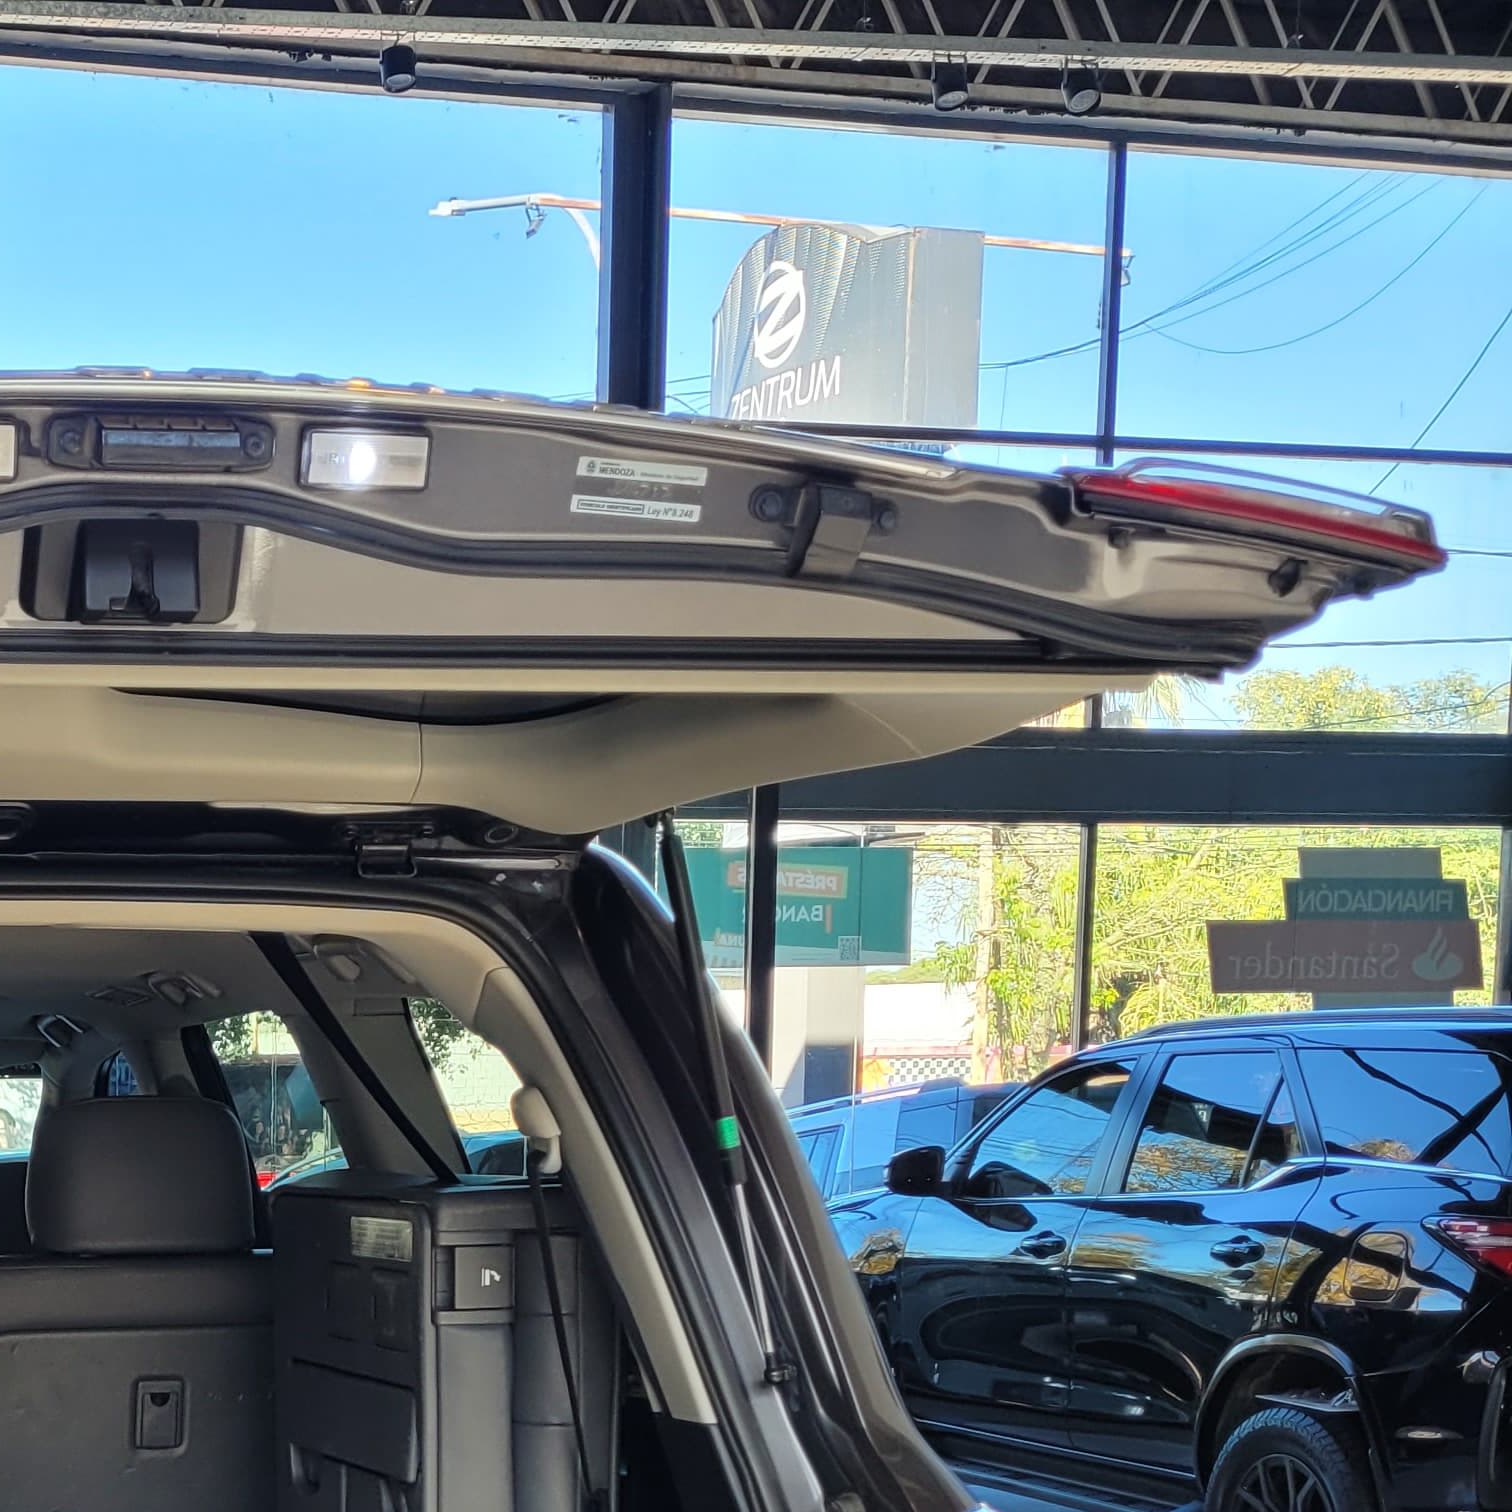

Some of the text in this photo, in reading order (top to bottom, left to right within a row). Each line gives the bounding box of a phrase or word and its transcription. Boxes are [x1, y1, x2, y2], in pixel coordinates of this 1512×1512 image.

[730, 354, 841, 420] ZENTRUM
[599, 466, 635, 477] MENDOZA
[647, 507, 660, 517] Ley
